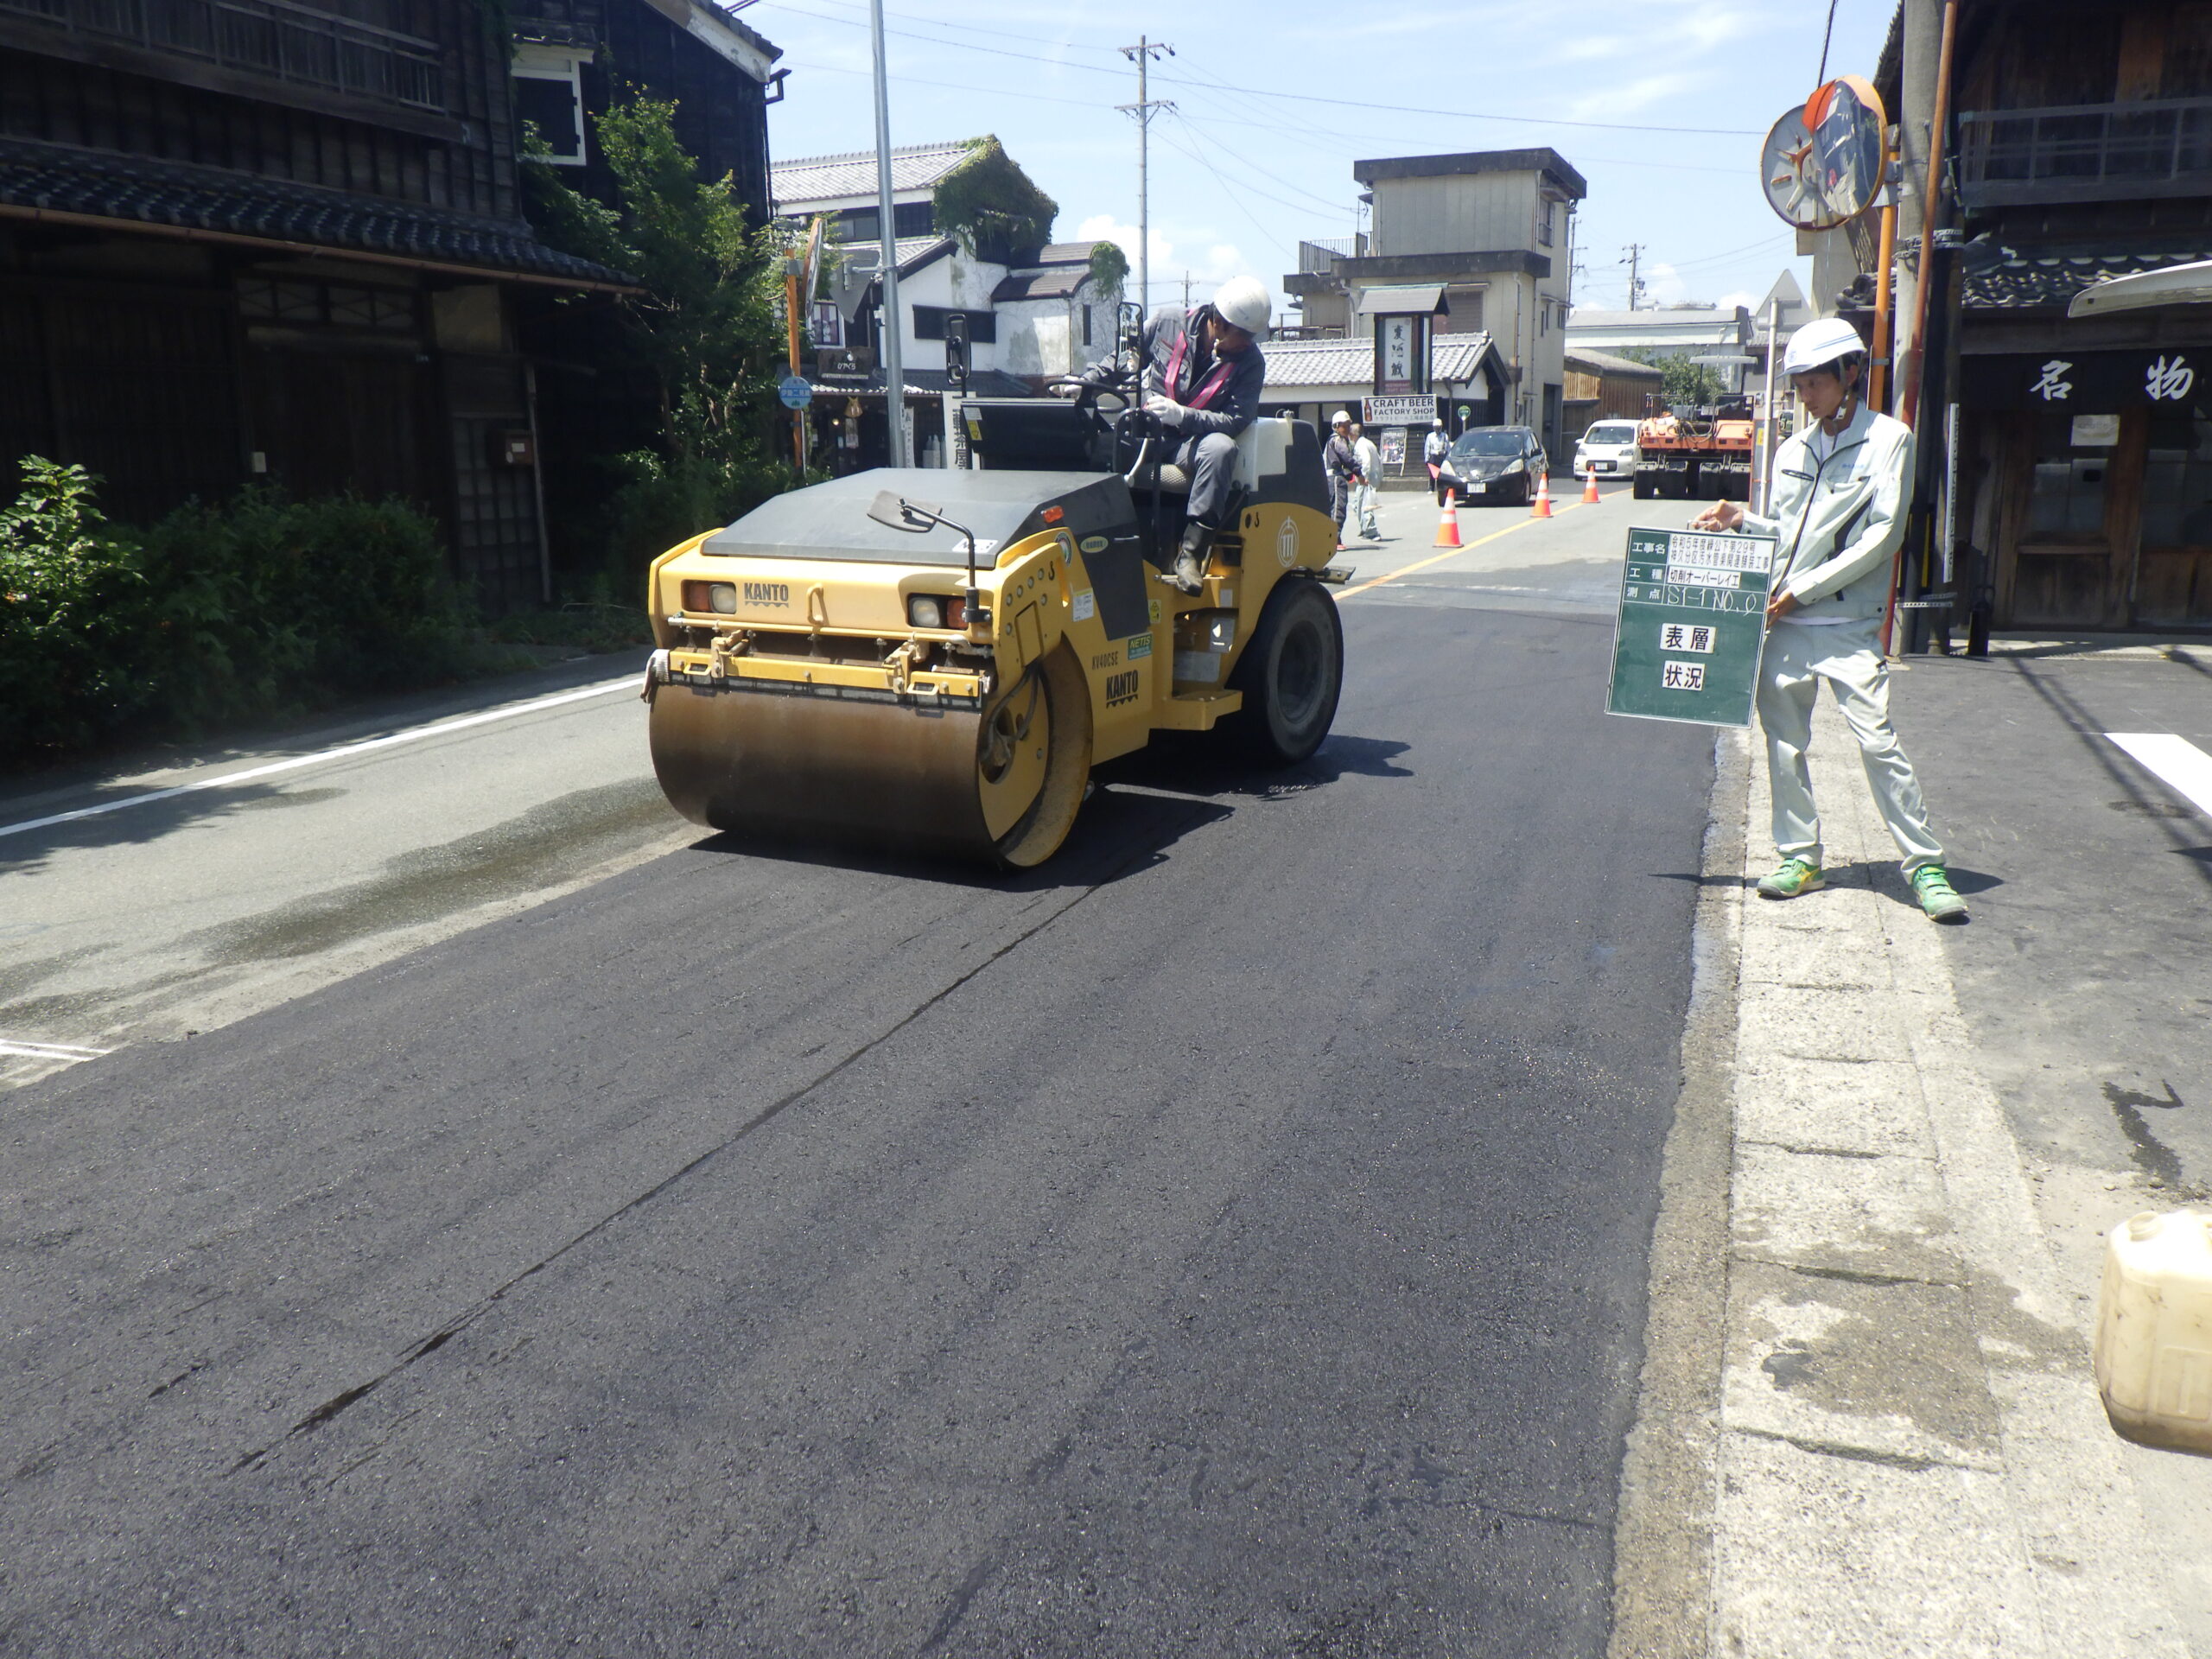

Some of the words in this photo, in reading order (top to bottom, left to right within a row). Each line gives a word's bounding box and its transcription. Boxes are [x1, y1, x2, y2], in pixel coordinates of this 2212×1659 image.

[2030, 355, 2194, 400] 名物
[1408, 398, 1433, 407] BEER
[1631, 542, 1665, 555] 工事名
[1670, 570, 1739, 586] 切削オーバーレイ工
[744, 582, 788, 601] KANTO
[1627, 587, 1660, 599] 測点
[1130, 635, 1150, 649] NETIS
[1666, 626, 1709, 651] 表層
[1106, 669, 1138, 700] KANTO
[1665, 664, 1702, 689] 状況
